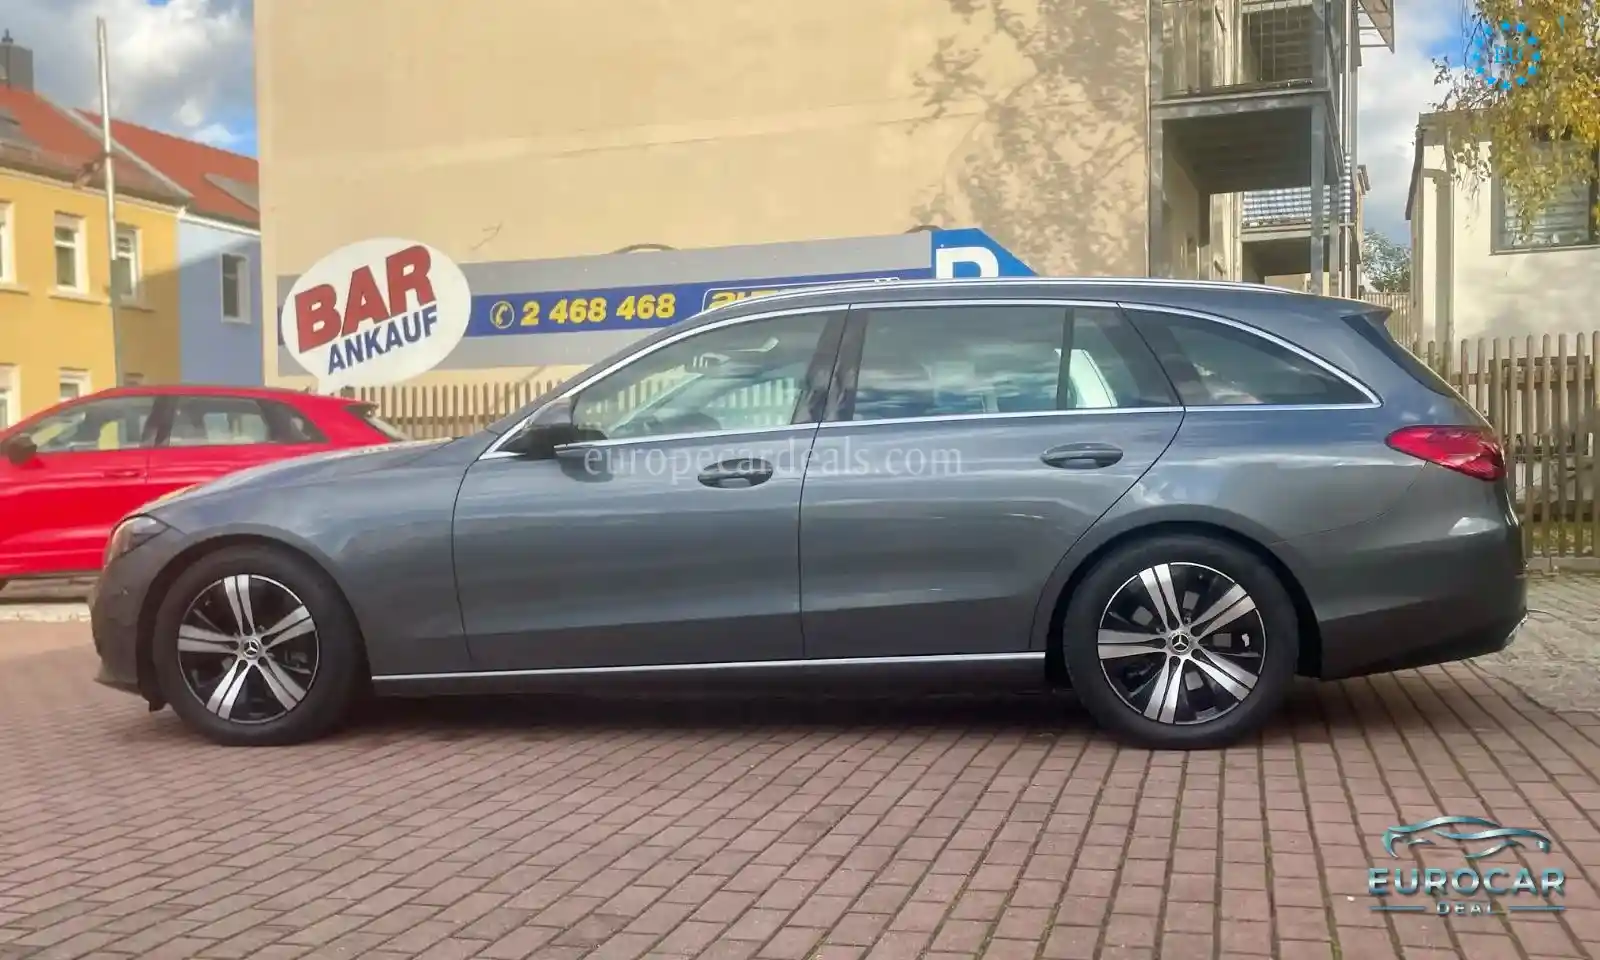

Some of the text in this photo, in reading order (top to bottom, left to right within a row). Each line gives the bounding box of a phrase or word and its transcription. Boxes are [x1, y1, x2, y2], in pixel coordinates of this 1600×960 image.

[294, 245, 438, 354] BAR
[520, 302, 540, 326] 2
[549, 297, 607, 324] 468
[616, 293, 676, 320] 468
[327, 304, 439, 376] ANKAUF
